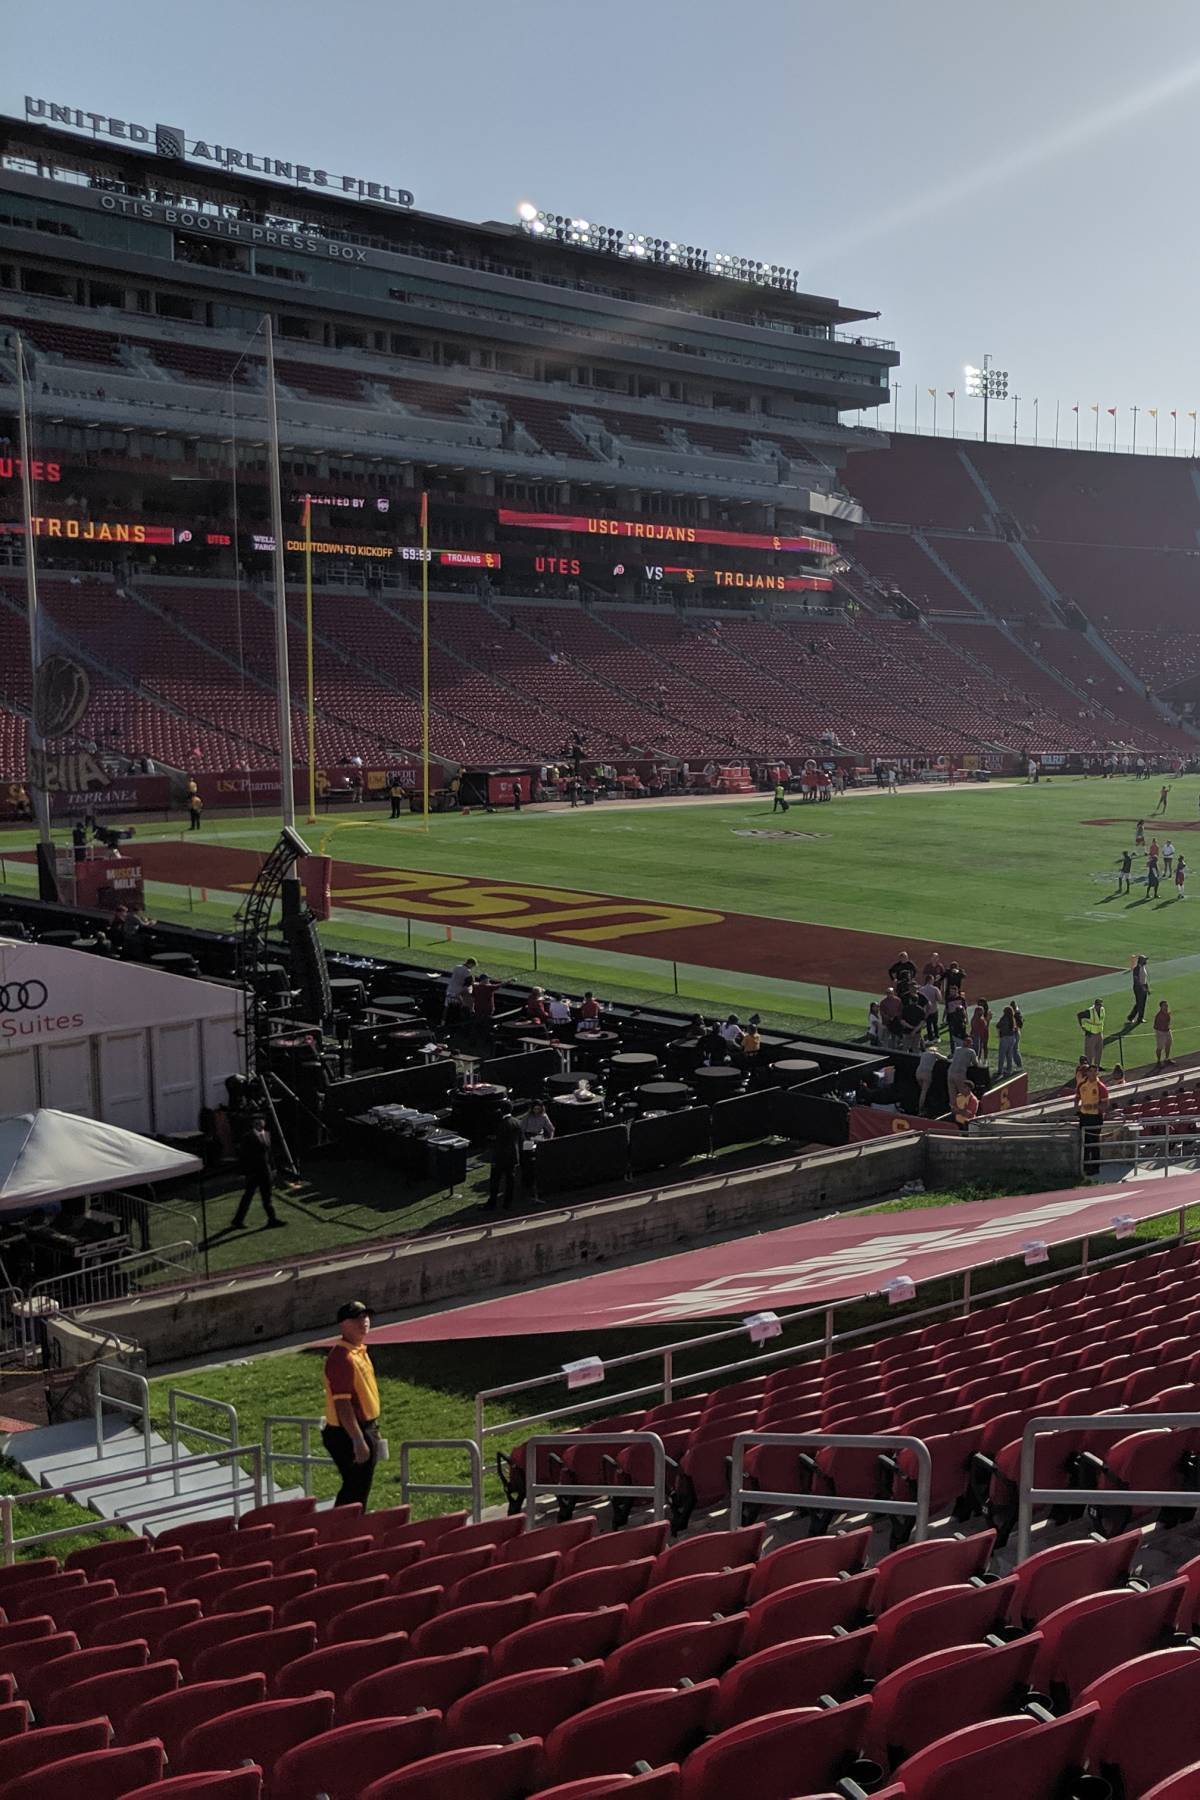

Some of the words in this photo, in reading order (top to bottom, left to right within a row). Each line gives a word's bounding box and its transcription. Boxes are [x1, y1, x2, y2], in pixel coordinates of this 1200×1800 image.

[25, 95, 149, 143] UNITED
[192, 140, 328, 186] AIRLINES
[342, 176, 415, 206] FIELD
[101, 196, 153, 217] OTIS
[165, 209, 240, 235] BOOTH
[252, 228, 317, 251] PRESS
[328, 244, 367, 262] BOX
[352, 499, 365, 508] BY
[32, 516, 146, 542] TROJANS
[588, 518, 618, 535] USC
[625, 522, 696, 542] TROJANS
[207, 535, 231, 545] UTES
[345, 545, 357, 555] TO
[358, 547, 393, 558] KICKOFF
[448, 553, 481, 564] TROJANS
[534, 557, 581, 575] UTES
[645, 565, 664, 580] VS
[714, 571, 785, 590] TROJANS
[217, 780, 240, 792] USC
[106, 866, 142, 880] MUSCLE
[113, 879, 137, 889] MILK
[1, 1012, 85, 1037] Suites
